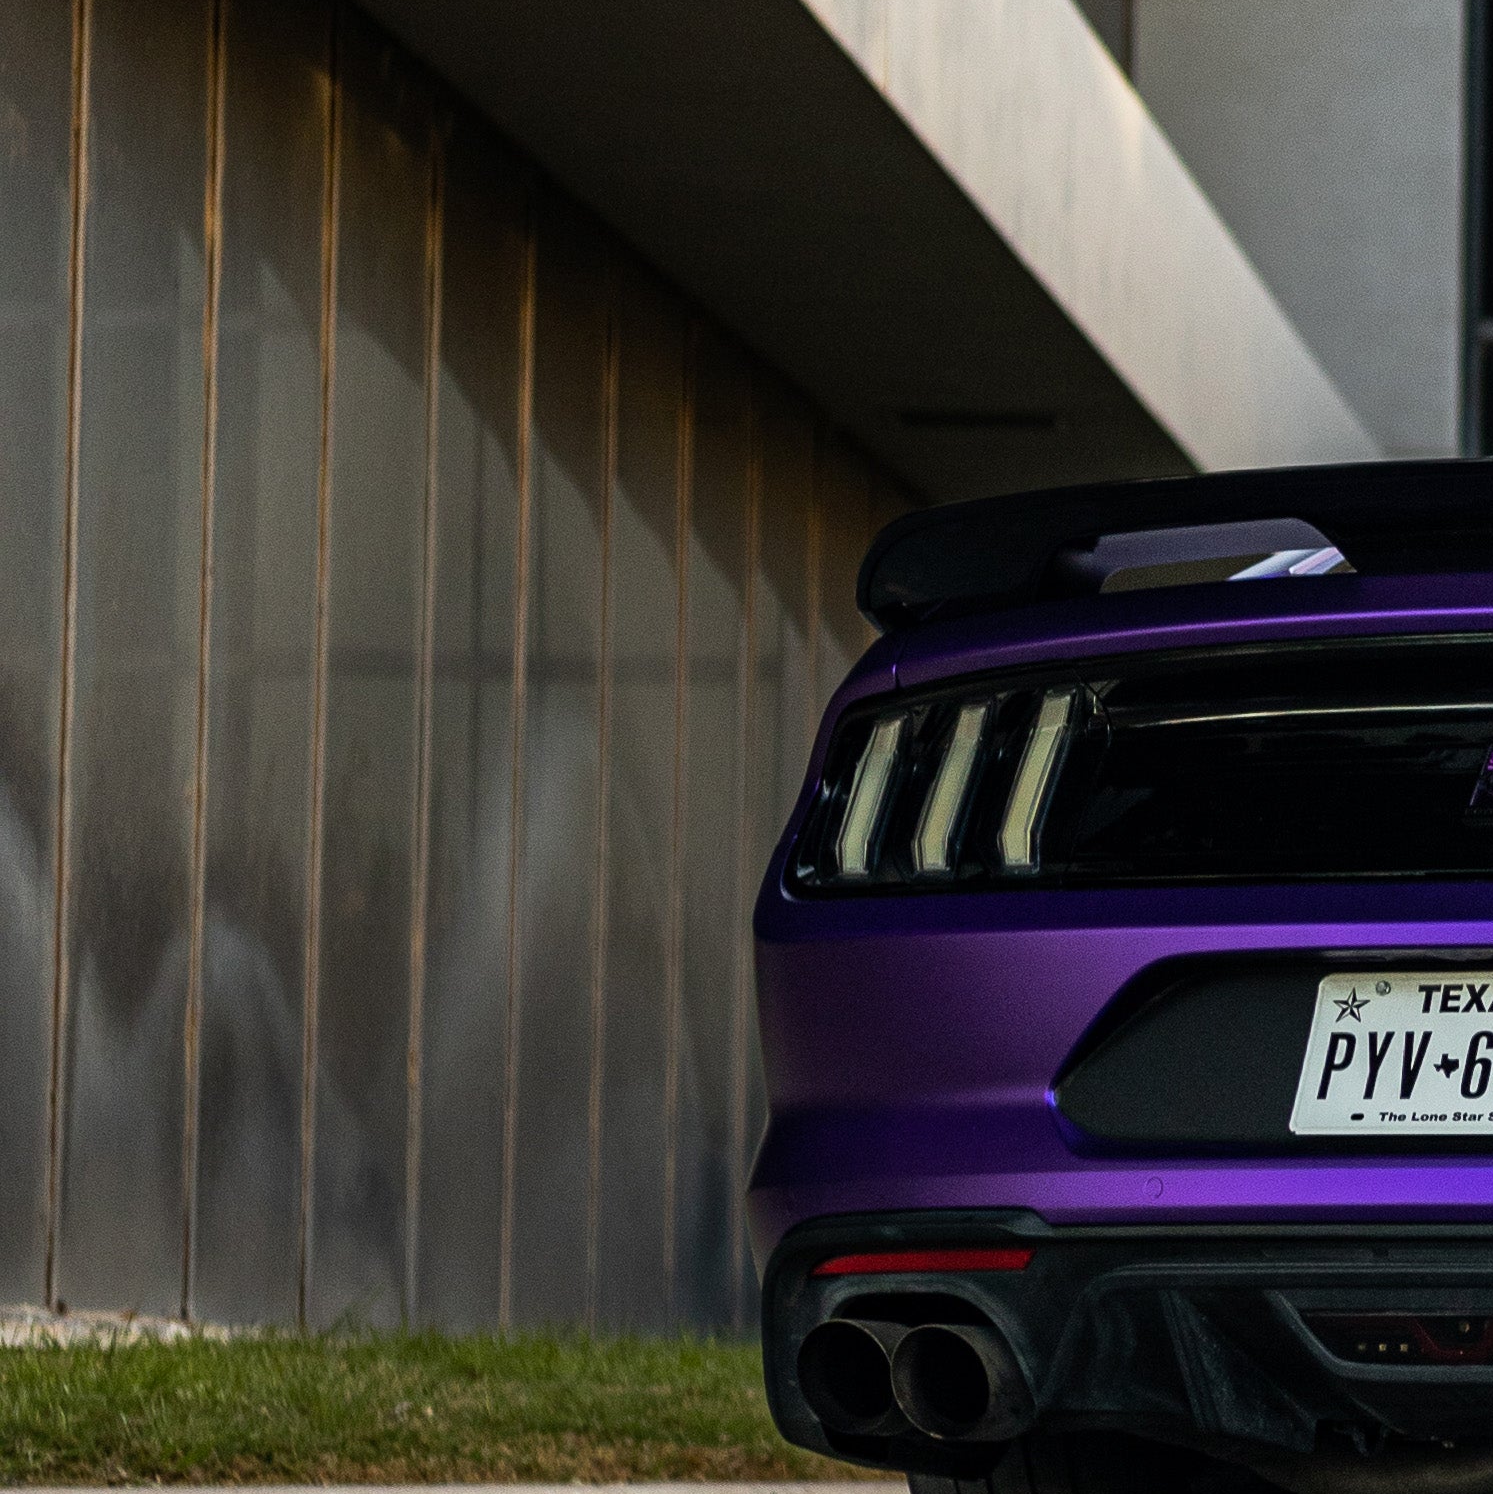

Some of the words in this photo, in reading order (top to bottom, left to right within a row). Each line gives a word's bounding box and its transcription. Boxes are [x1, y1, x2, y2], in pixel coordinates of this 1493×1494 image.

[1316, 1030, 1433, 1100] PYV
[1379, 1111, 1407, 1122] The
[1411, 1111, 1447, 1122] Lone
[1452, 1111, 1484, 1122] Star
